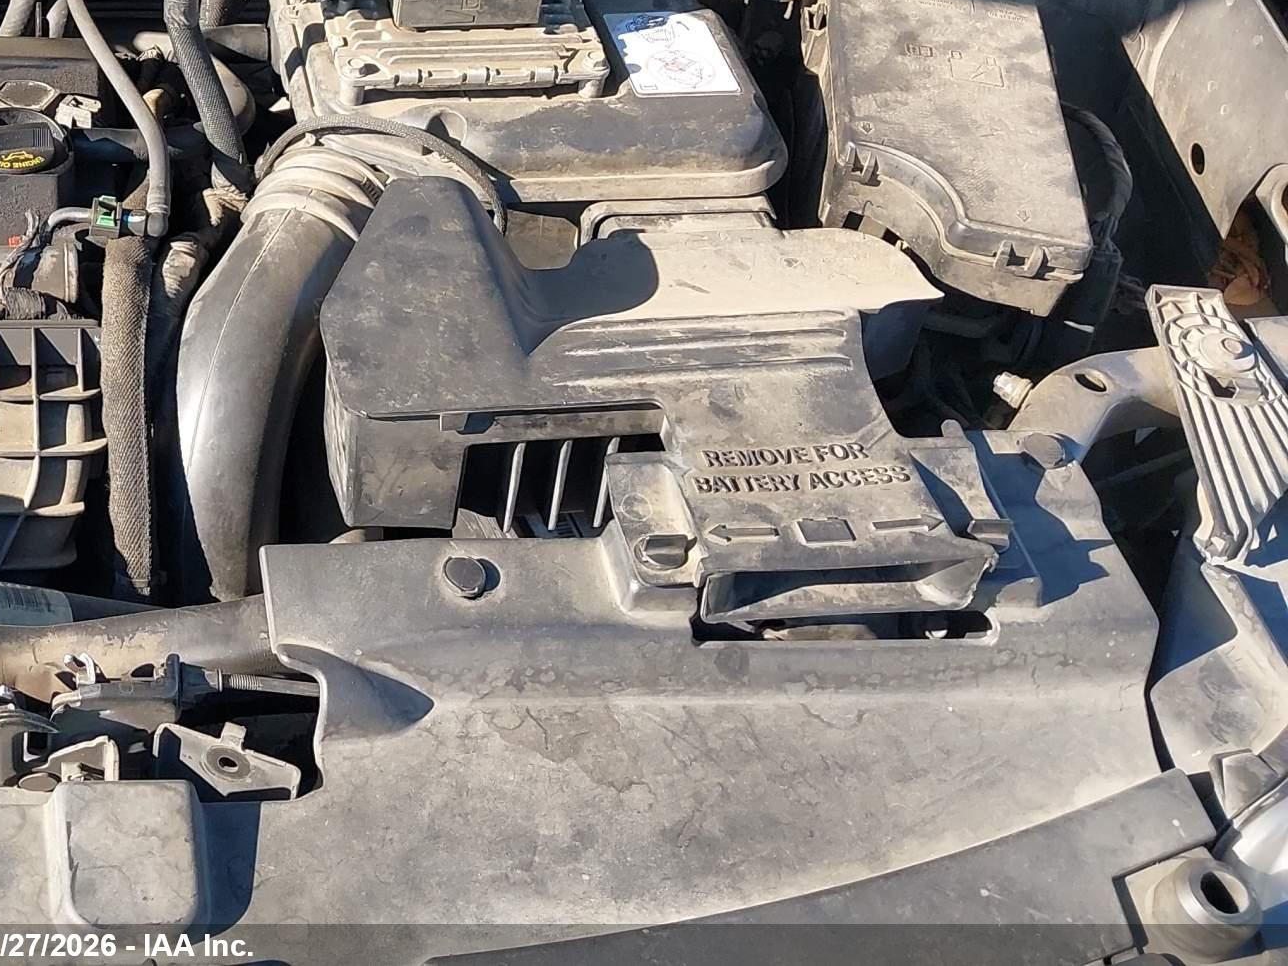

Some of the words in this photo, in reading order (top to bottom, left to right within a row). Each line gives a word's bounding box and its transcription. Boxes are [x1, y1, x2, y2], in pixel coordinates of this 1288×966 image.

[13, 156, 45, 168] ENGINE
[701, 447, 812, 467] REMOVE
[813, 442, 869, 464] FOR
[692, 473, 800, 494] BATTERY
[808, 465, 911, 490] ACCESS
